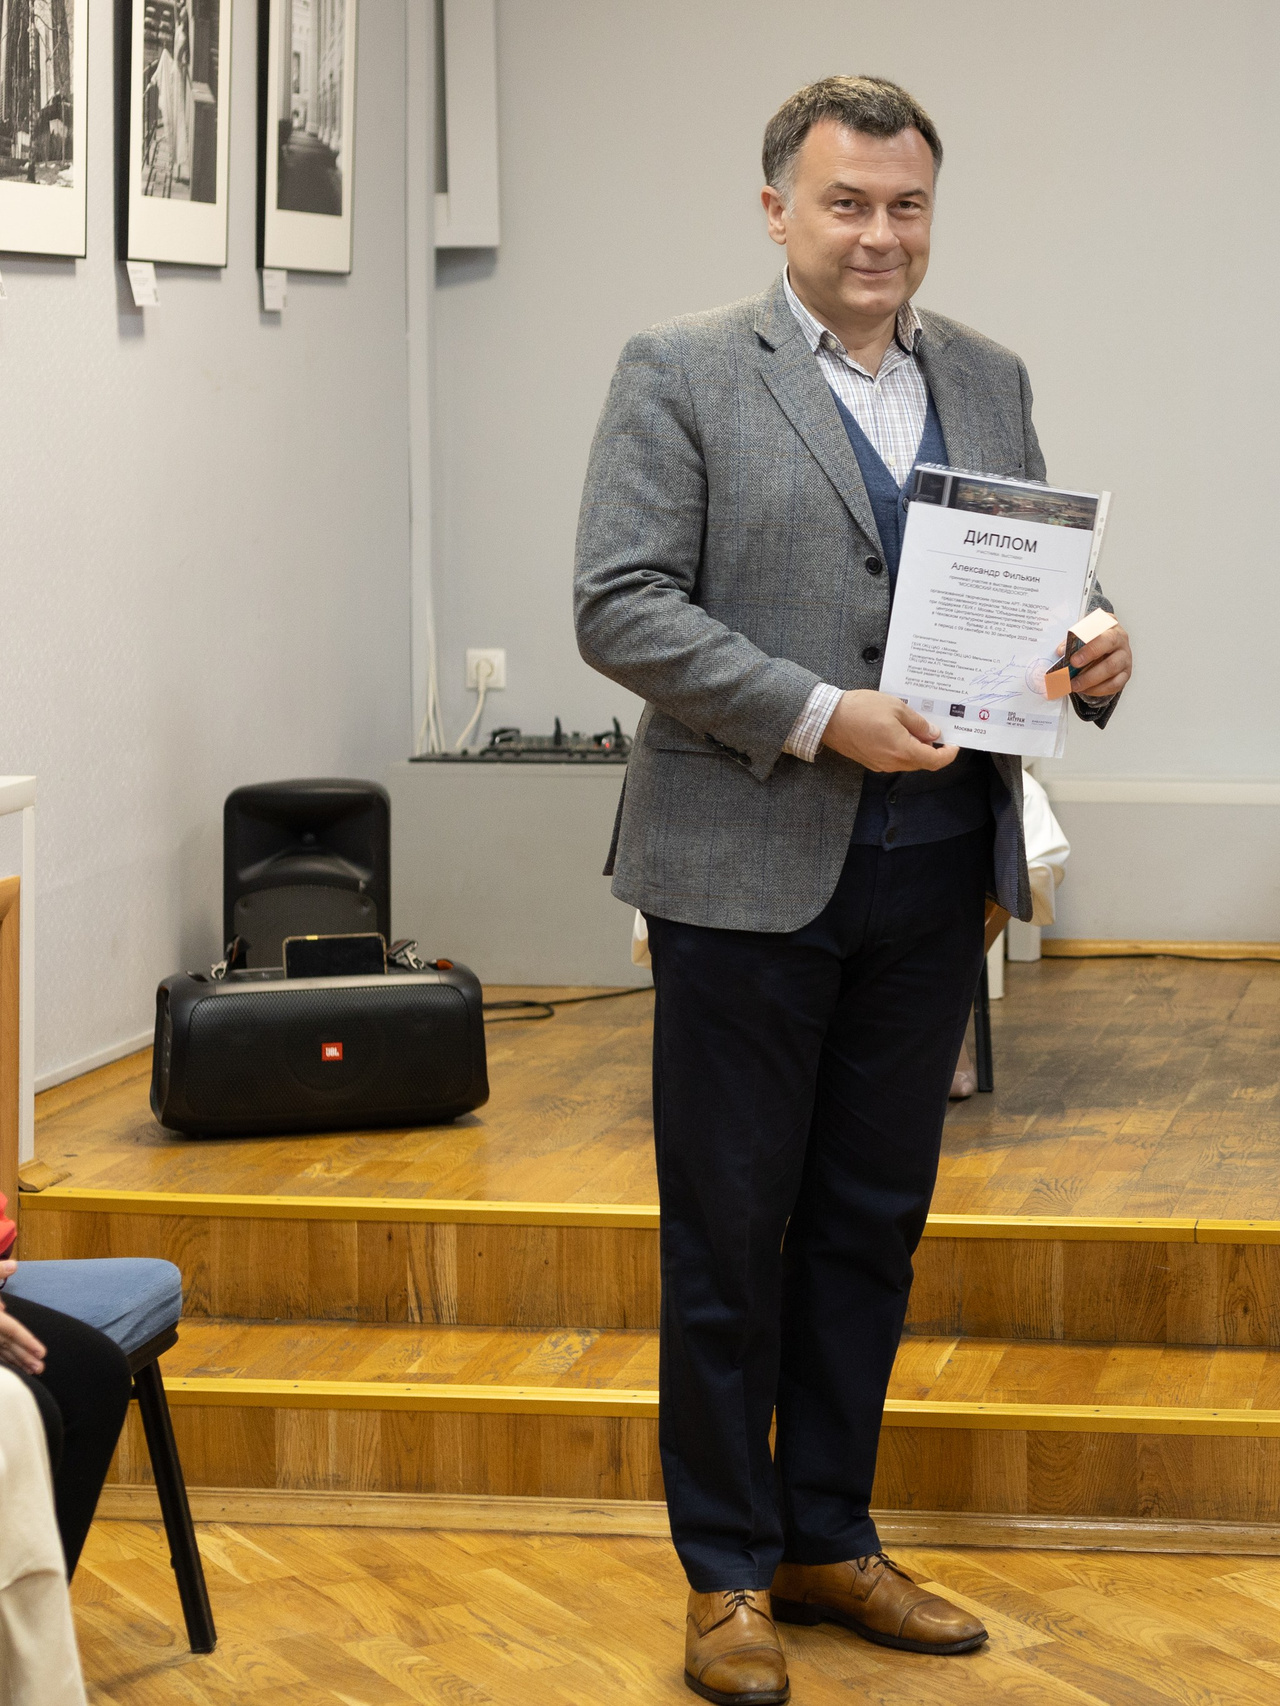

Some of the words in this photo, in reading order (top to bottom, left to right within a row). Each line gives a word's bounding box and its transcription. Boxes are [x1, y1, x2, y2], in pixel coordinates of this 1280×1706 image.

[964, 530, 1037, 553] ДИПЛОМ
[951, 562, 1000, 578] Александр
[1003, 570, 1040, 583] Филькин
[954, 725, 972, 733] Москва
[974, 727, 987, 735] 2023
[325, 1046, 340, 1057] JBL
